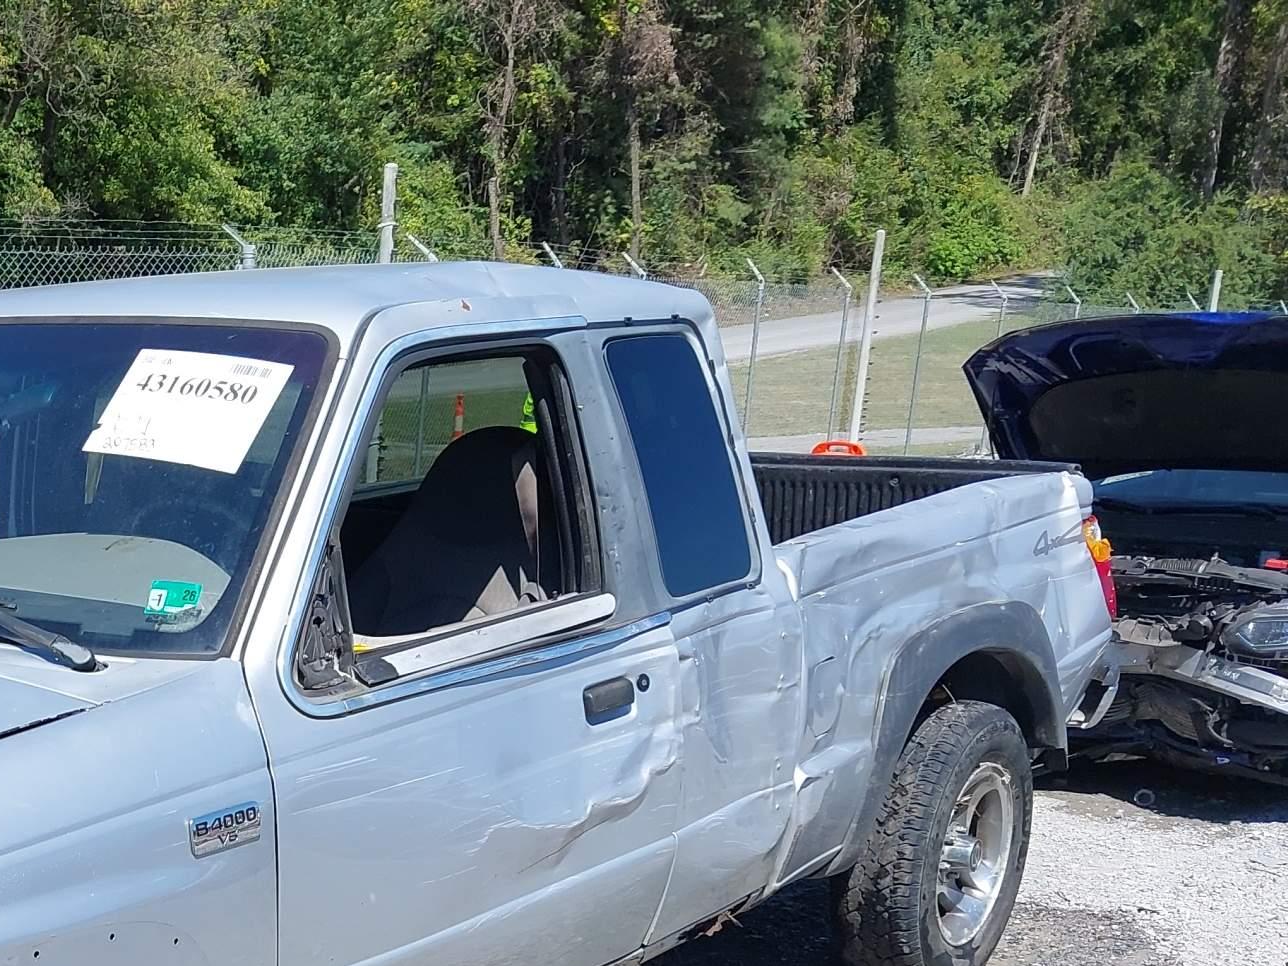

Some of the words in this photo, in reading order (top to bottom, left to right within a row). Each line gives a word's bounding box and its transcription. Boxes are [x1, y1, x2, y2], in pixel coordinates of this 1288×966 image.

[136, 372, 258, 404] 43160580
[182, 589, 197, 602] 26
[195, 806, 257, 837] B4000
